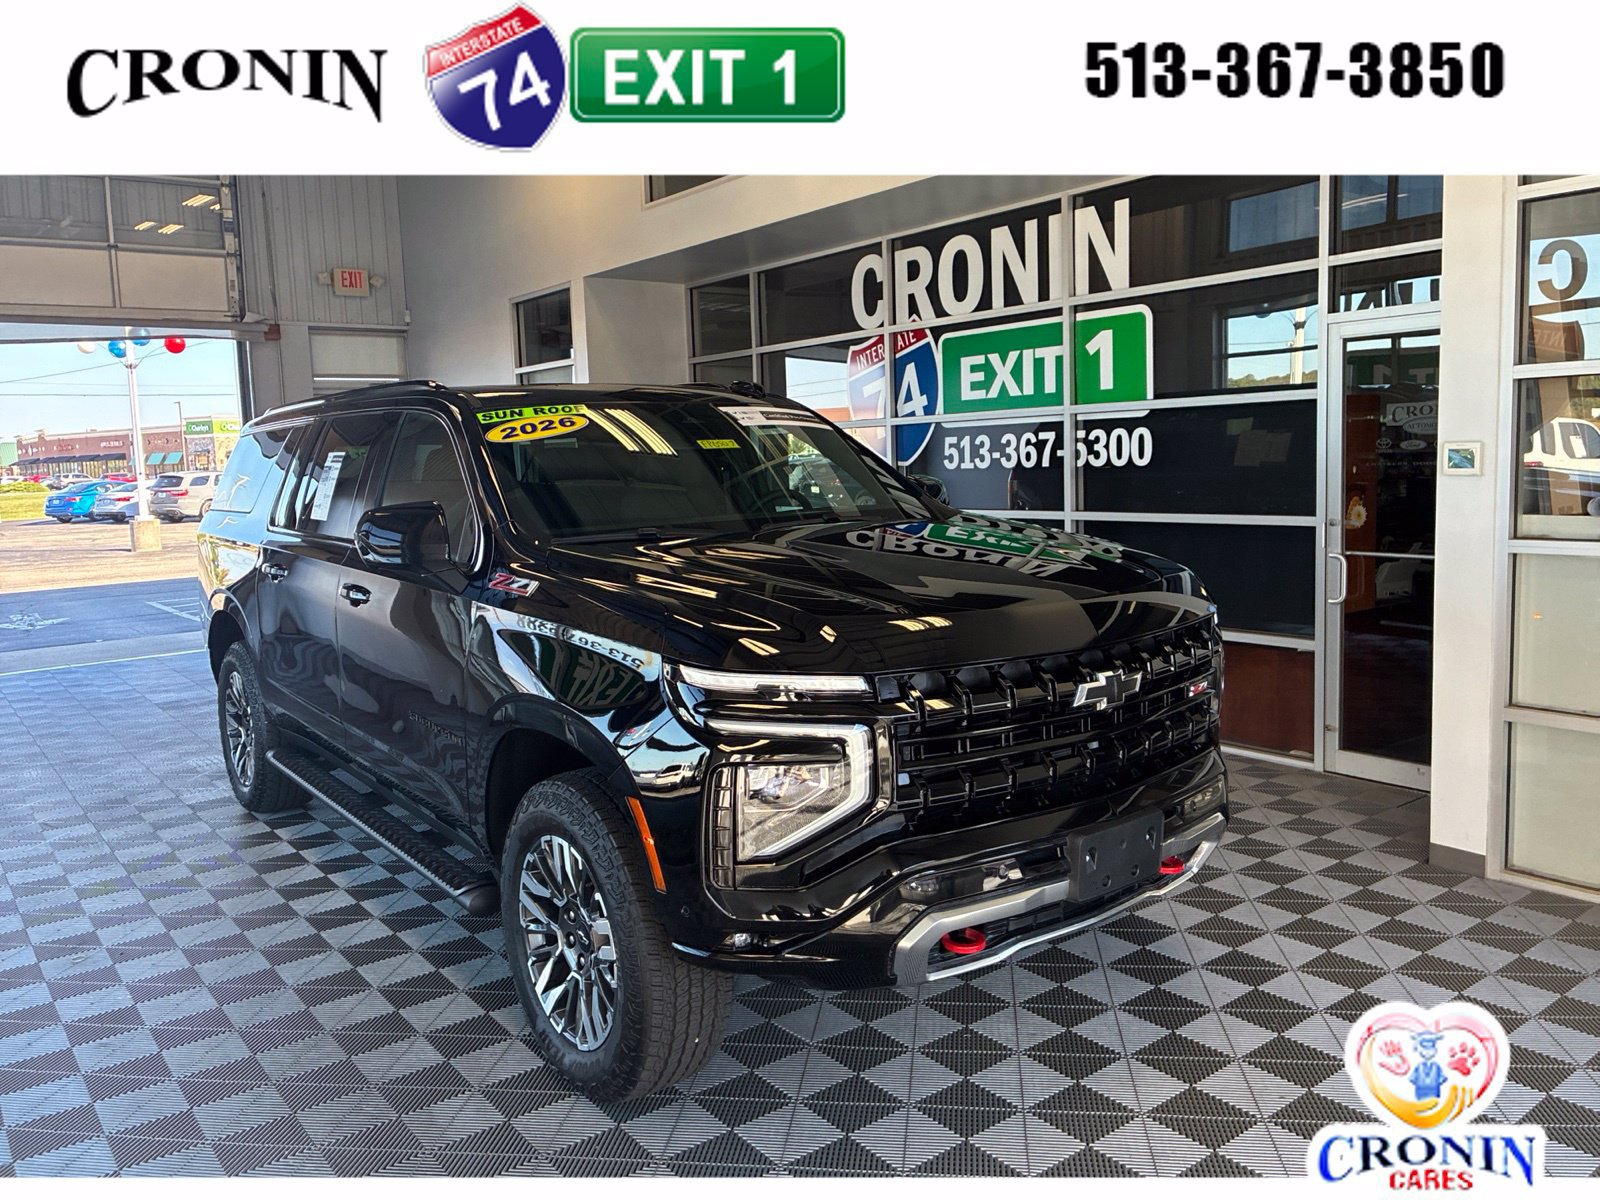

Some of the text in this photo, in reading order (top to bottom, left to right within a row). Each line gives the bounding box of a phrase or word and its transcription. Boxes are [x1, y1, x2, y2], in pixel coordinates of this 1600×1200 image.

[340, 270, 365, 289] EXIT
[850, 197, 1131, 331] CRONIN
[960, 328, 1115, 402] EXIT 1
[480, 404, 586, 422] SUN ROOF
[861, 361, 929, 441] 74
[499, 416, 578, 441] 2026
[943, 426, 1154, 470] 513-367-5300
